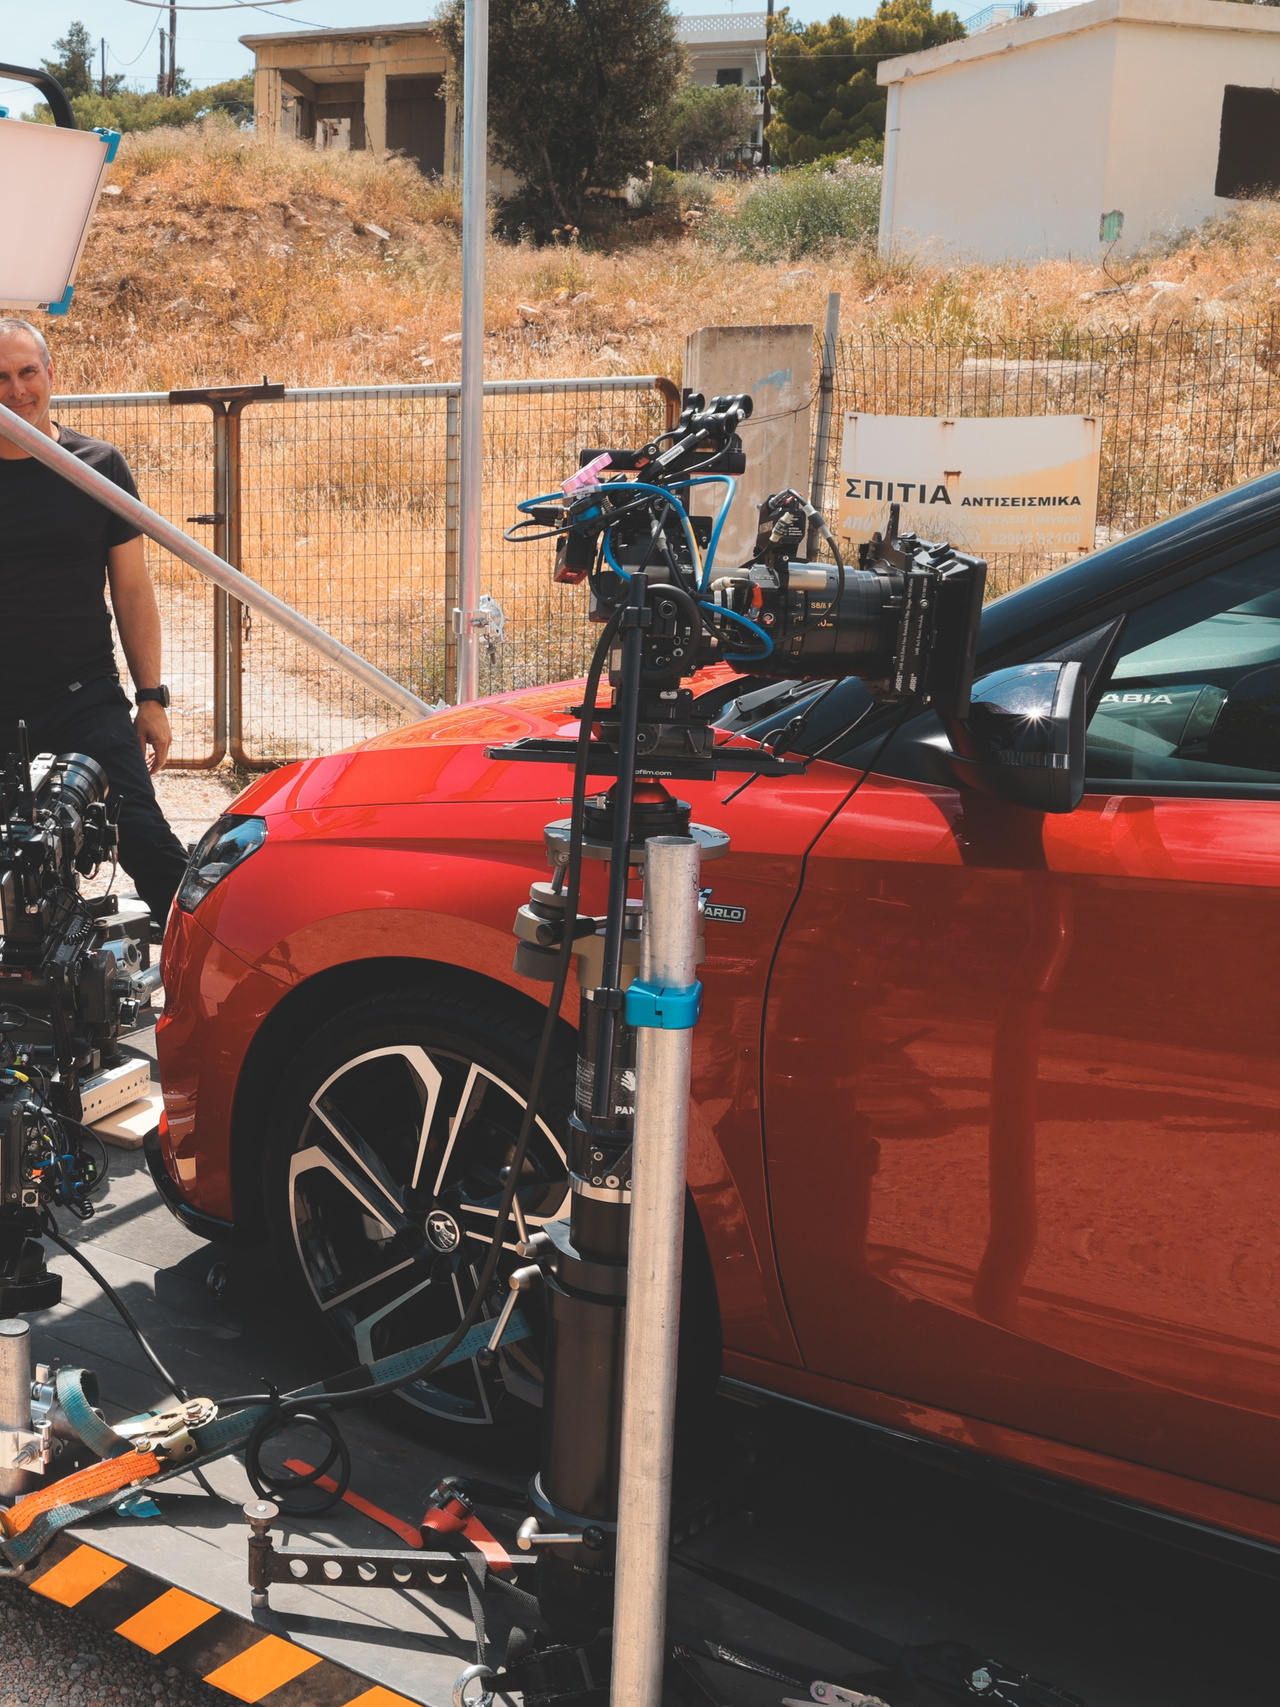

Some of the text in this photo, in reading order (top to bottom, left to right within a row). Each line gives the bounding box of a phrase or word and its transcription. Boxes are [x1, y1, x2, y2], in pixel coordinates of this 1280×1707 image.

[845, 478, 1081, 507] ΣΠΙΤΙΑ ΑΝΤΙΣΕΙΣΜΙΚΑ
[1100, 693, 1173, 705] ABIA
[705, 907, 742, 919] ARLO
[614, 1106, 635, 1115] PAN
